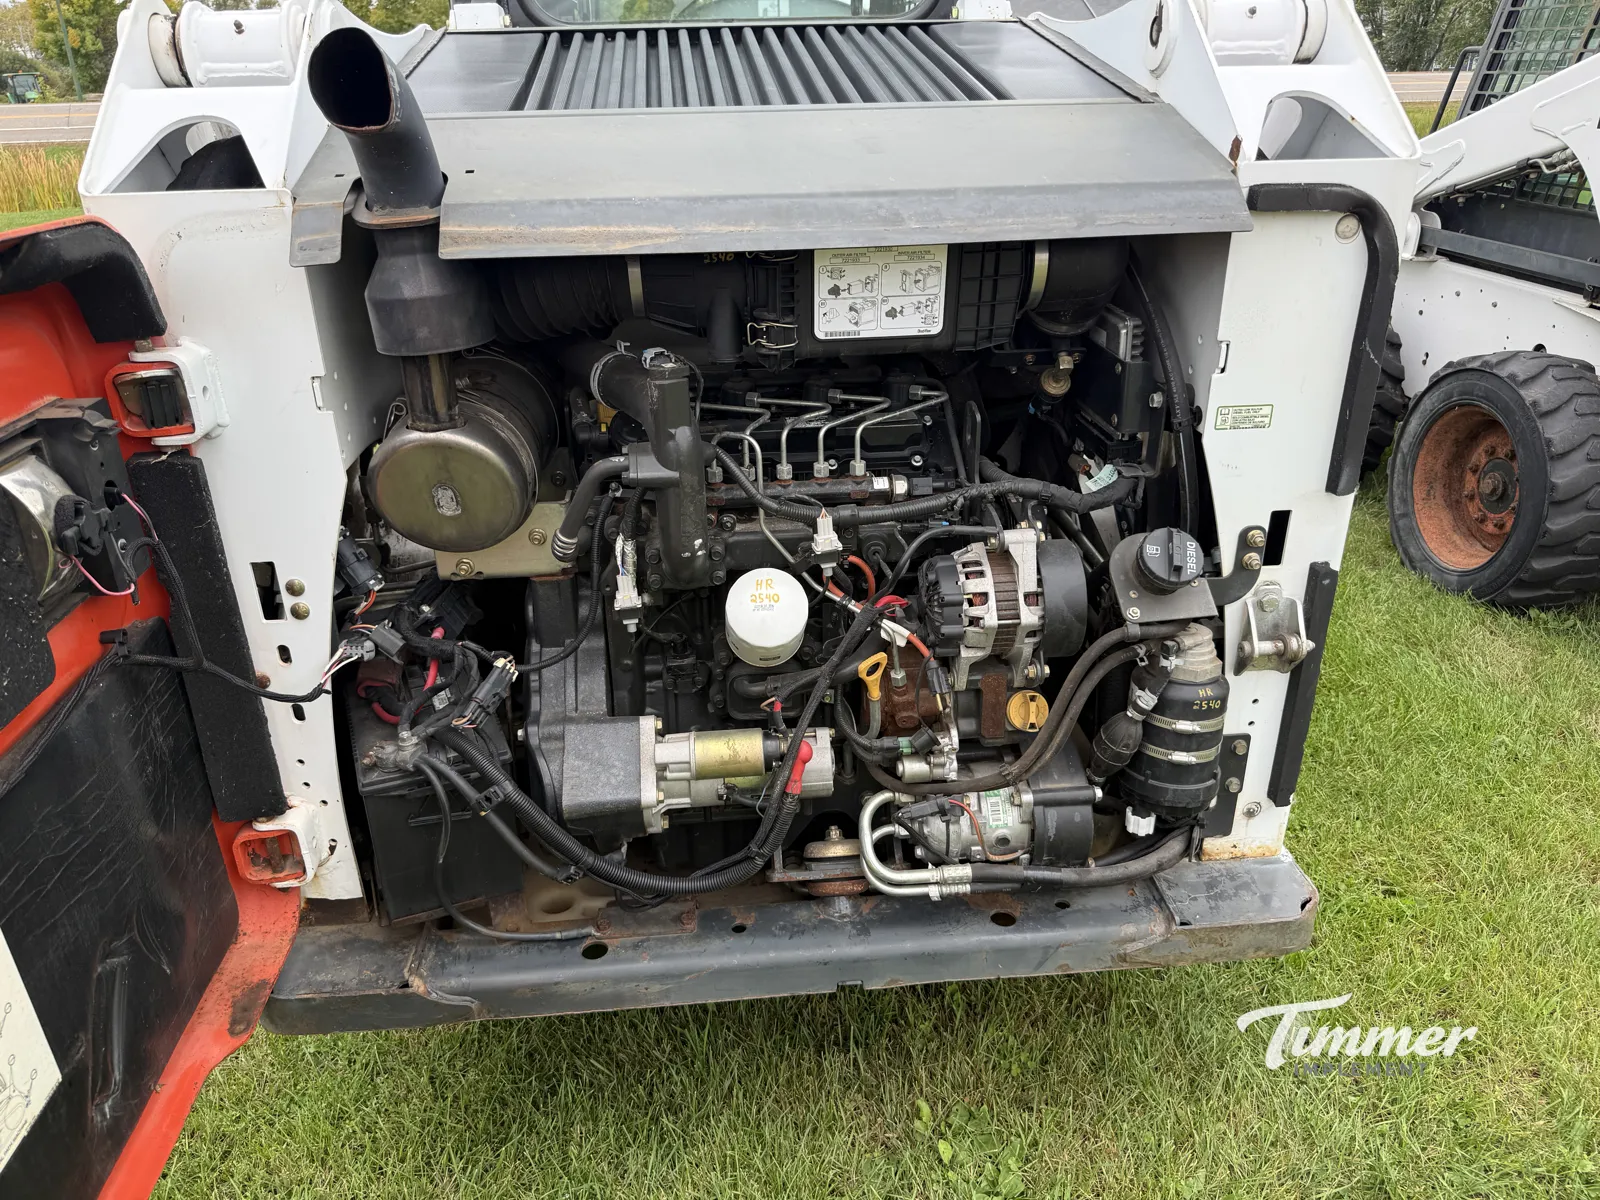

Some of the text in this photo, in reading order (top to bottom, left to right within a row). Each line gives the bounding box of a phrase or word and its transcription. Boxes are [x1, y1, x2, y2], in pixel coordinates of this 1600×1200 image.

[1186, 541, 1197, 575] DIESEL
[755, 578, 775, 591] HR
[750, 593, 780, 604] 2540
[1198, 687, 1214, 698] HR
[1192, 700, 1221, 710] 2540
